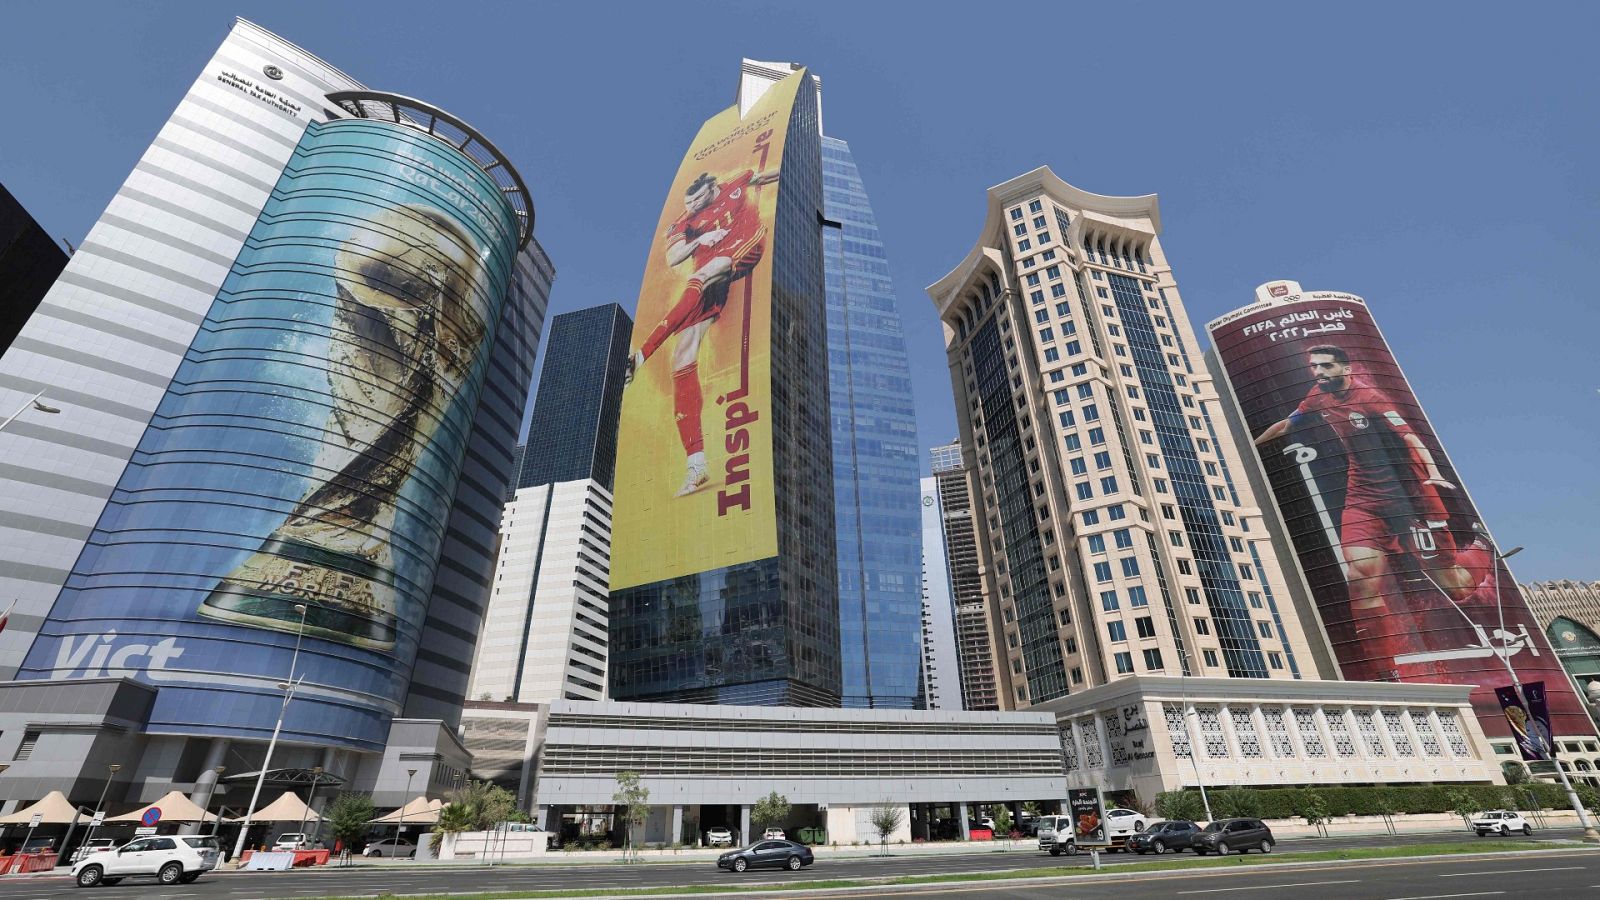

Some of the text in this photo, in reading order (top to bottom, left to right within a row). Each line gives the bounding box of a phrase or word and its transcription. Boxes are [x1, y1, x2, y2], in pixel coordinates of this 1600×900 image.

[217, 75, 299, 118] GENERAL TAX AUTHORITY
[1242, 306, 1354, 337] كأس العالم FIFA
[1243, 302, 1273, 315] Committee
[1302, 318, 1346, 338] قطر
[1409, 526, 1437, 551] 10
[288, 564, 374, 600] FIFA
[50, 628, 185, 682] Vict
[1123, 704, 1138, 721] برج
